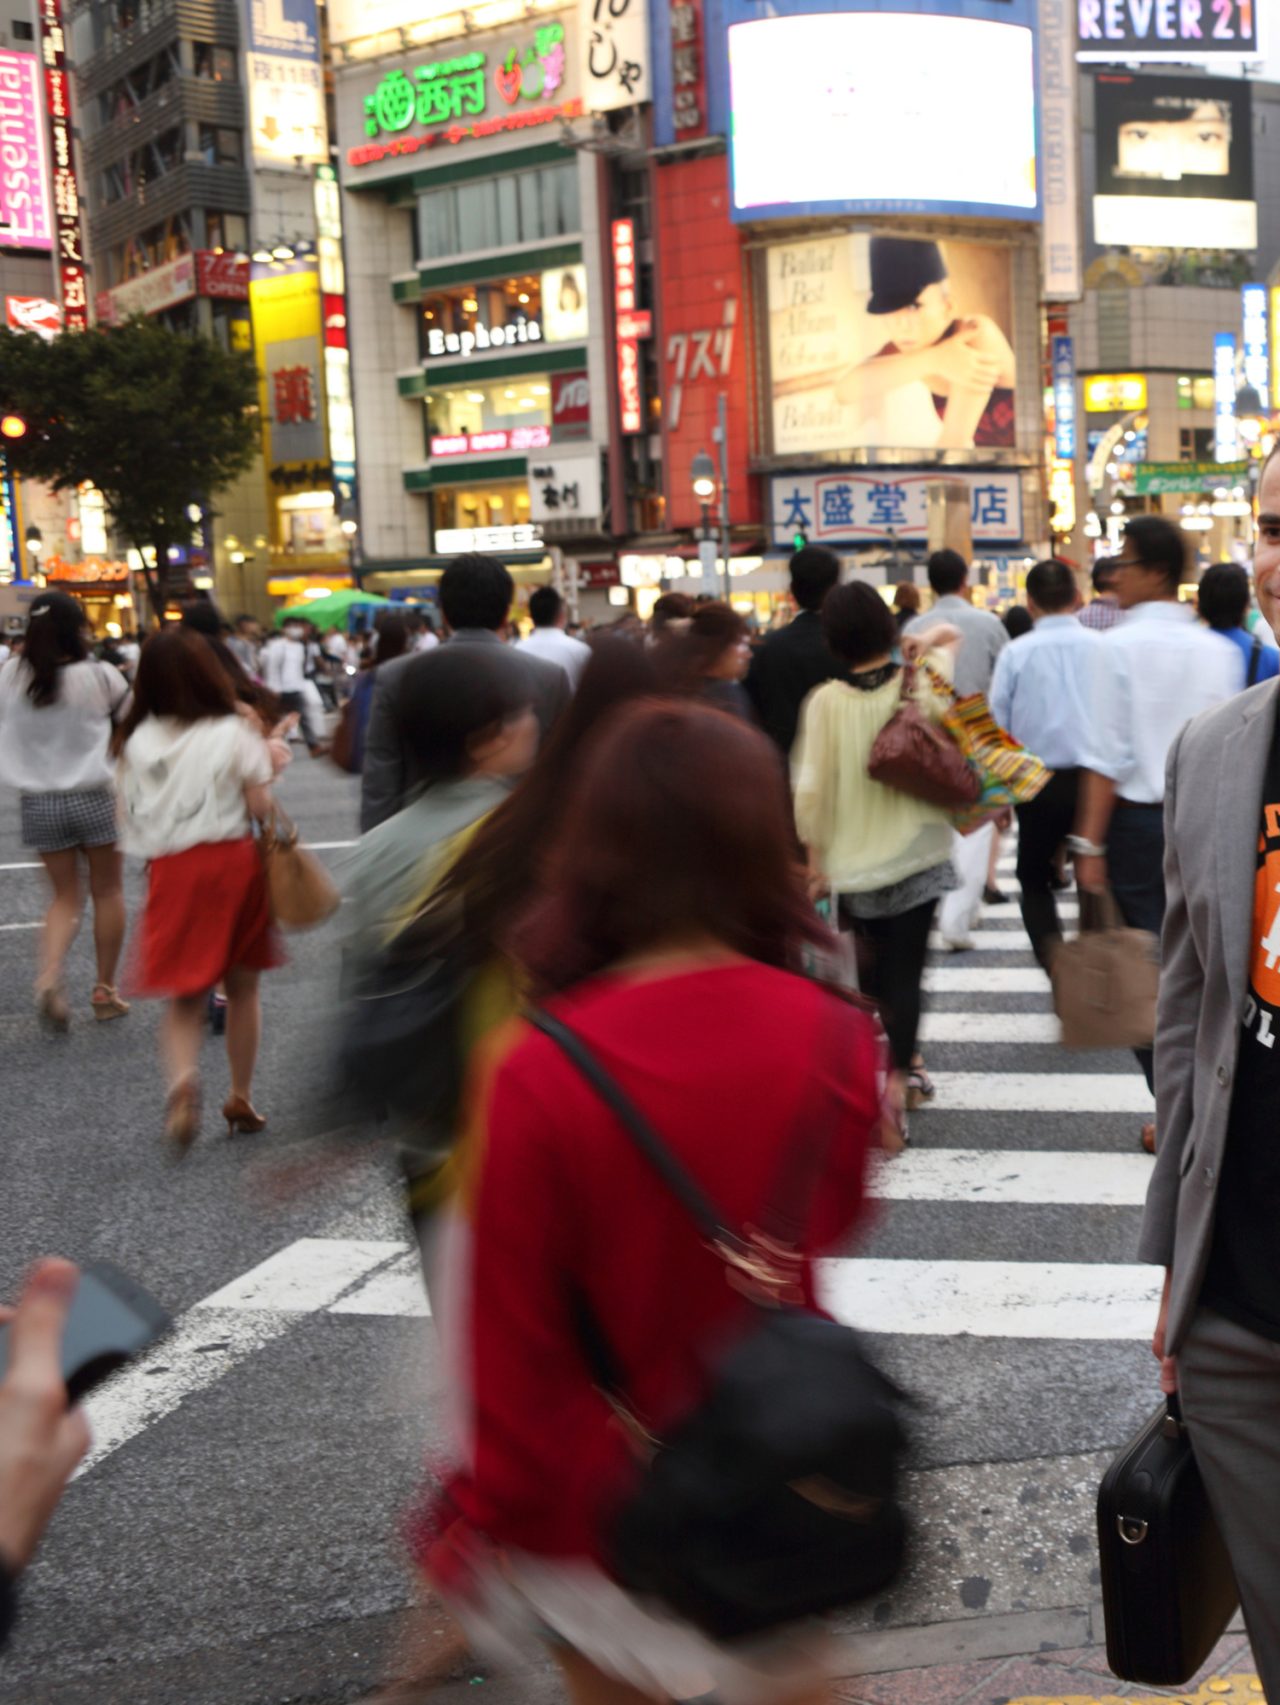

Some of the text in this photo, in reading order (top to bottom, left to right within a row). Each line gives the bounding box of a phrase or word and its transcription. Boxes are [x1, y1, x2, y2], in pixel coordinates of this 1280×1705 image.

[1078, 0, 1253, 40] REVER 21
[428, 315, 541, 357] Euphoria
[666, 297, 738, 432] クスリ
[555, 378, 590, 414] JTB
[783, 483, 1008, 528] 大盛堂店
